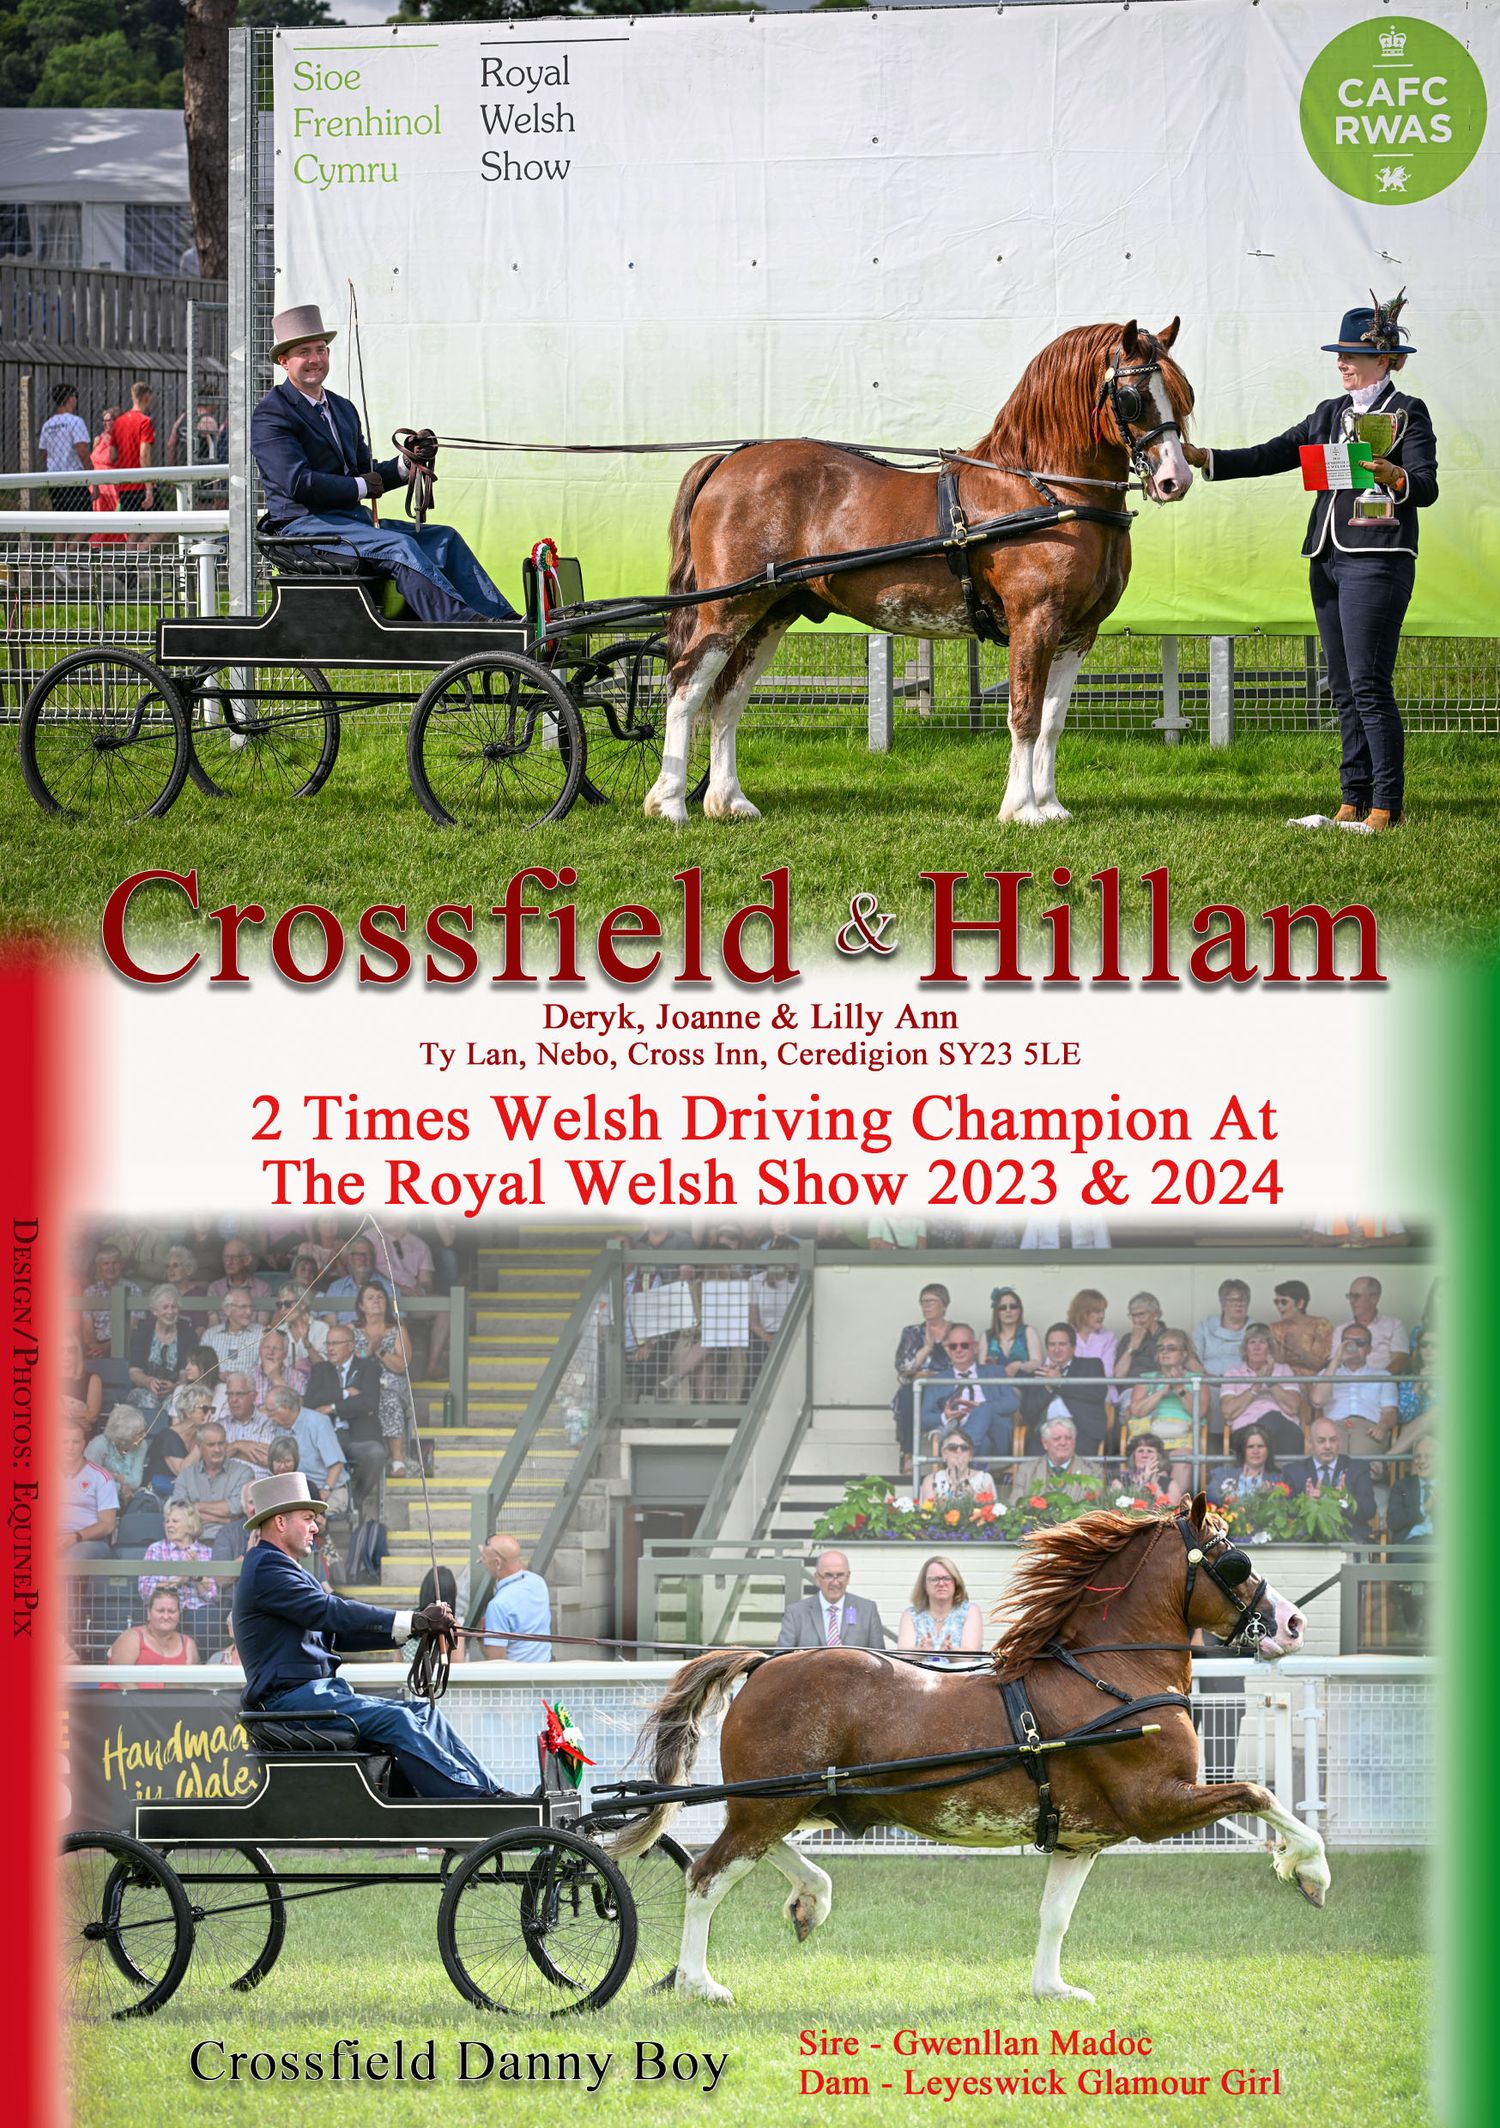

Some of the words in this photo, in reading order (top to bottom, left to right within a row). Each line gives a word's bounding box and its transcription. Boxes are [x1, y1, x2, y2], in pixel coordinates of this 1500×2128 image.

[293, 60, 361, 92] Sioe
[480, 54, 571, 94] Royal
[1337, 76, 1449, 108] CAFC
[293, 104, 442, 138] Frenhinol
[479, 102, 577, 135] Welsh
[1334, 112, 1453, 146] RWAS
[293, 153, 399, 192] Cymru
[480, 150, 572, 182] Show
[176, 1757, 258, 1799] Wale
